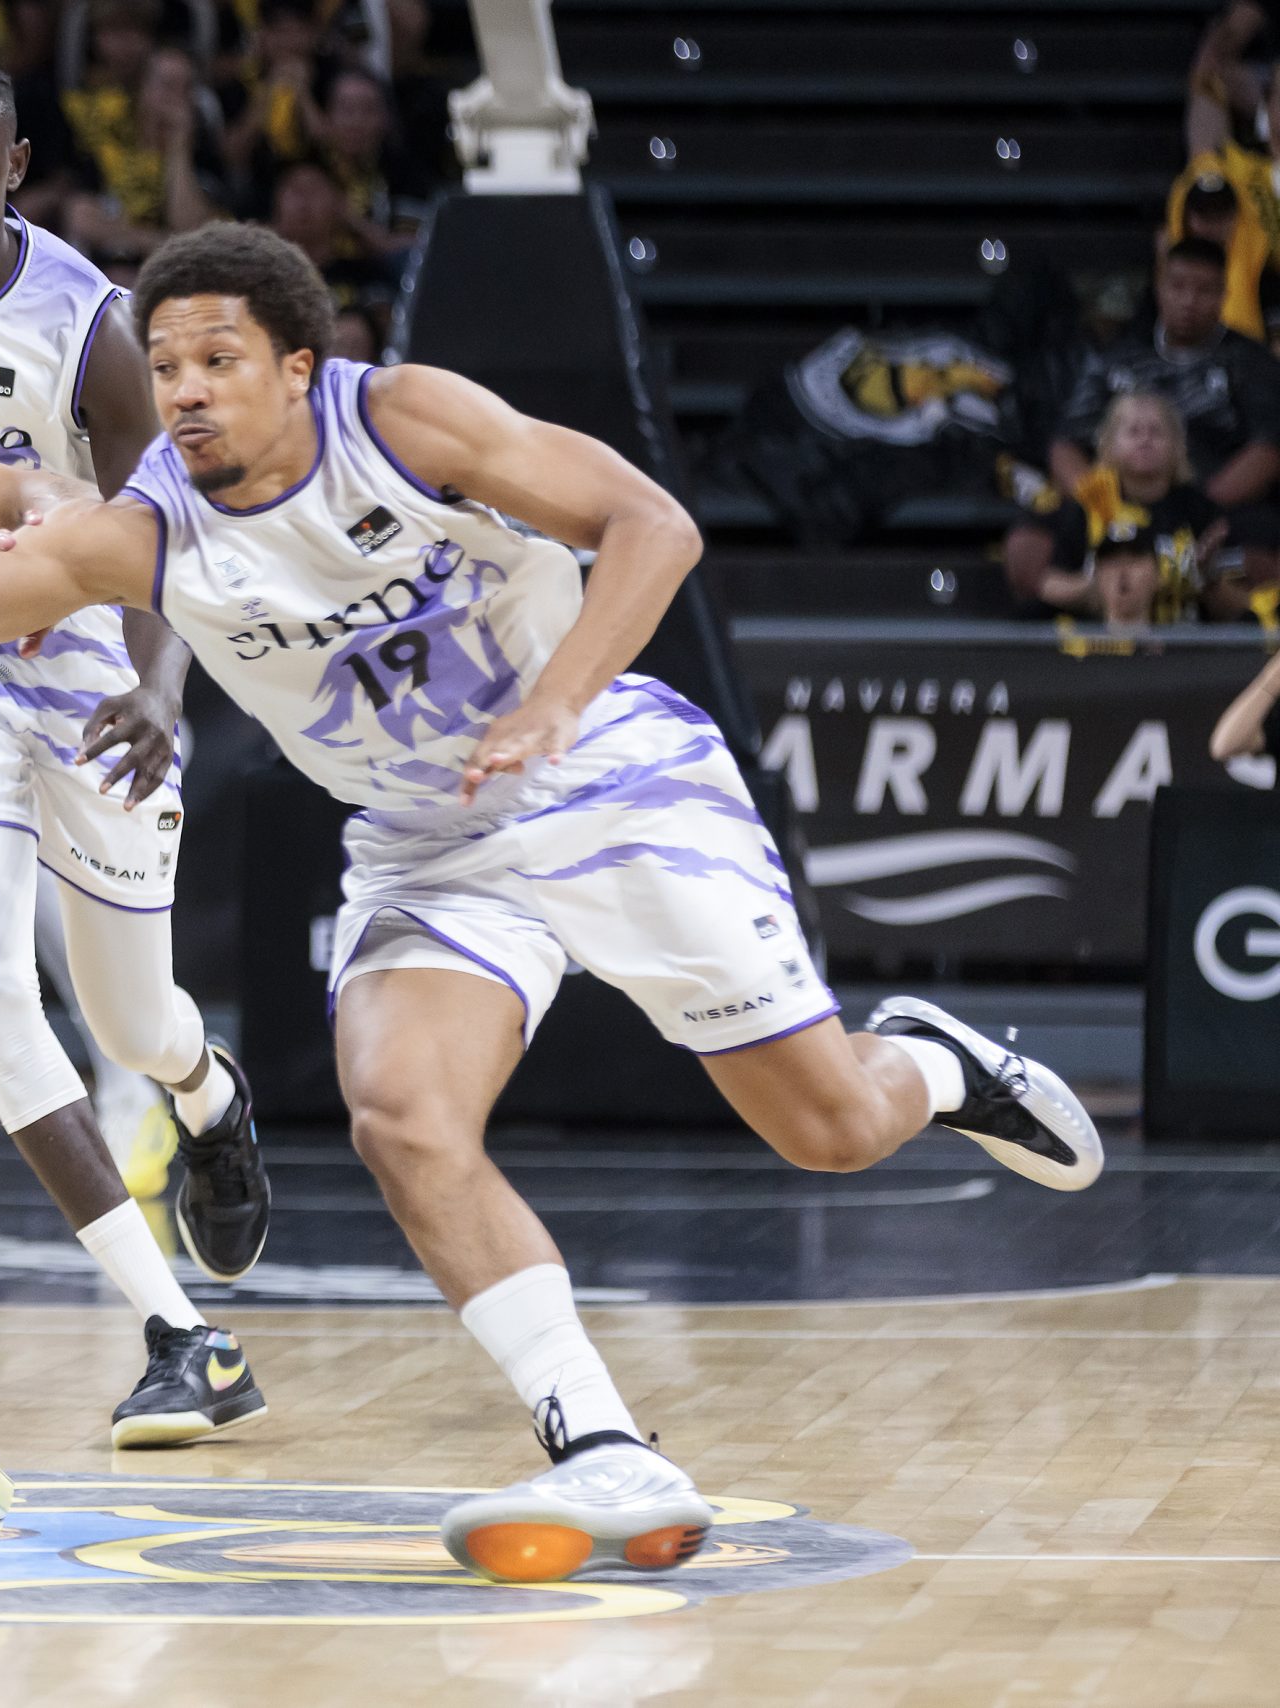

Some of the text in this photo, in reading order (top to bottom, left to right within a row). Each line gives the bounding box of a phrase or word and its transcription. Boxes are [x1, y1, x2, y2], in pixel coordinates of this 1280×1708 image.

[355, 529, 375, 546] liga
[363, 522, 401, 553] endesa
[341, 629, 432, 713] 19
[785, 676, 1010, 714] NAVIERA
[70, 847, 146, 881] NISSAN
[683, 993, 775, 1023] NISSAN
